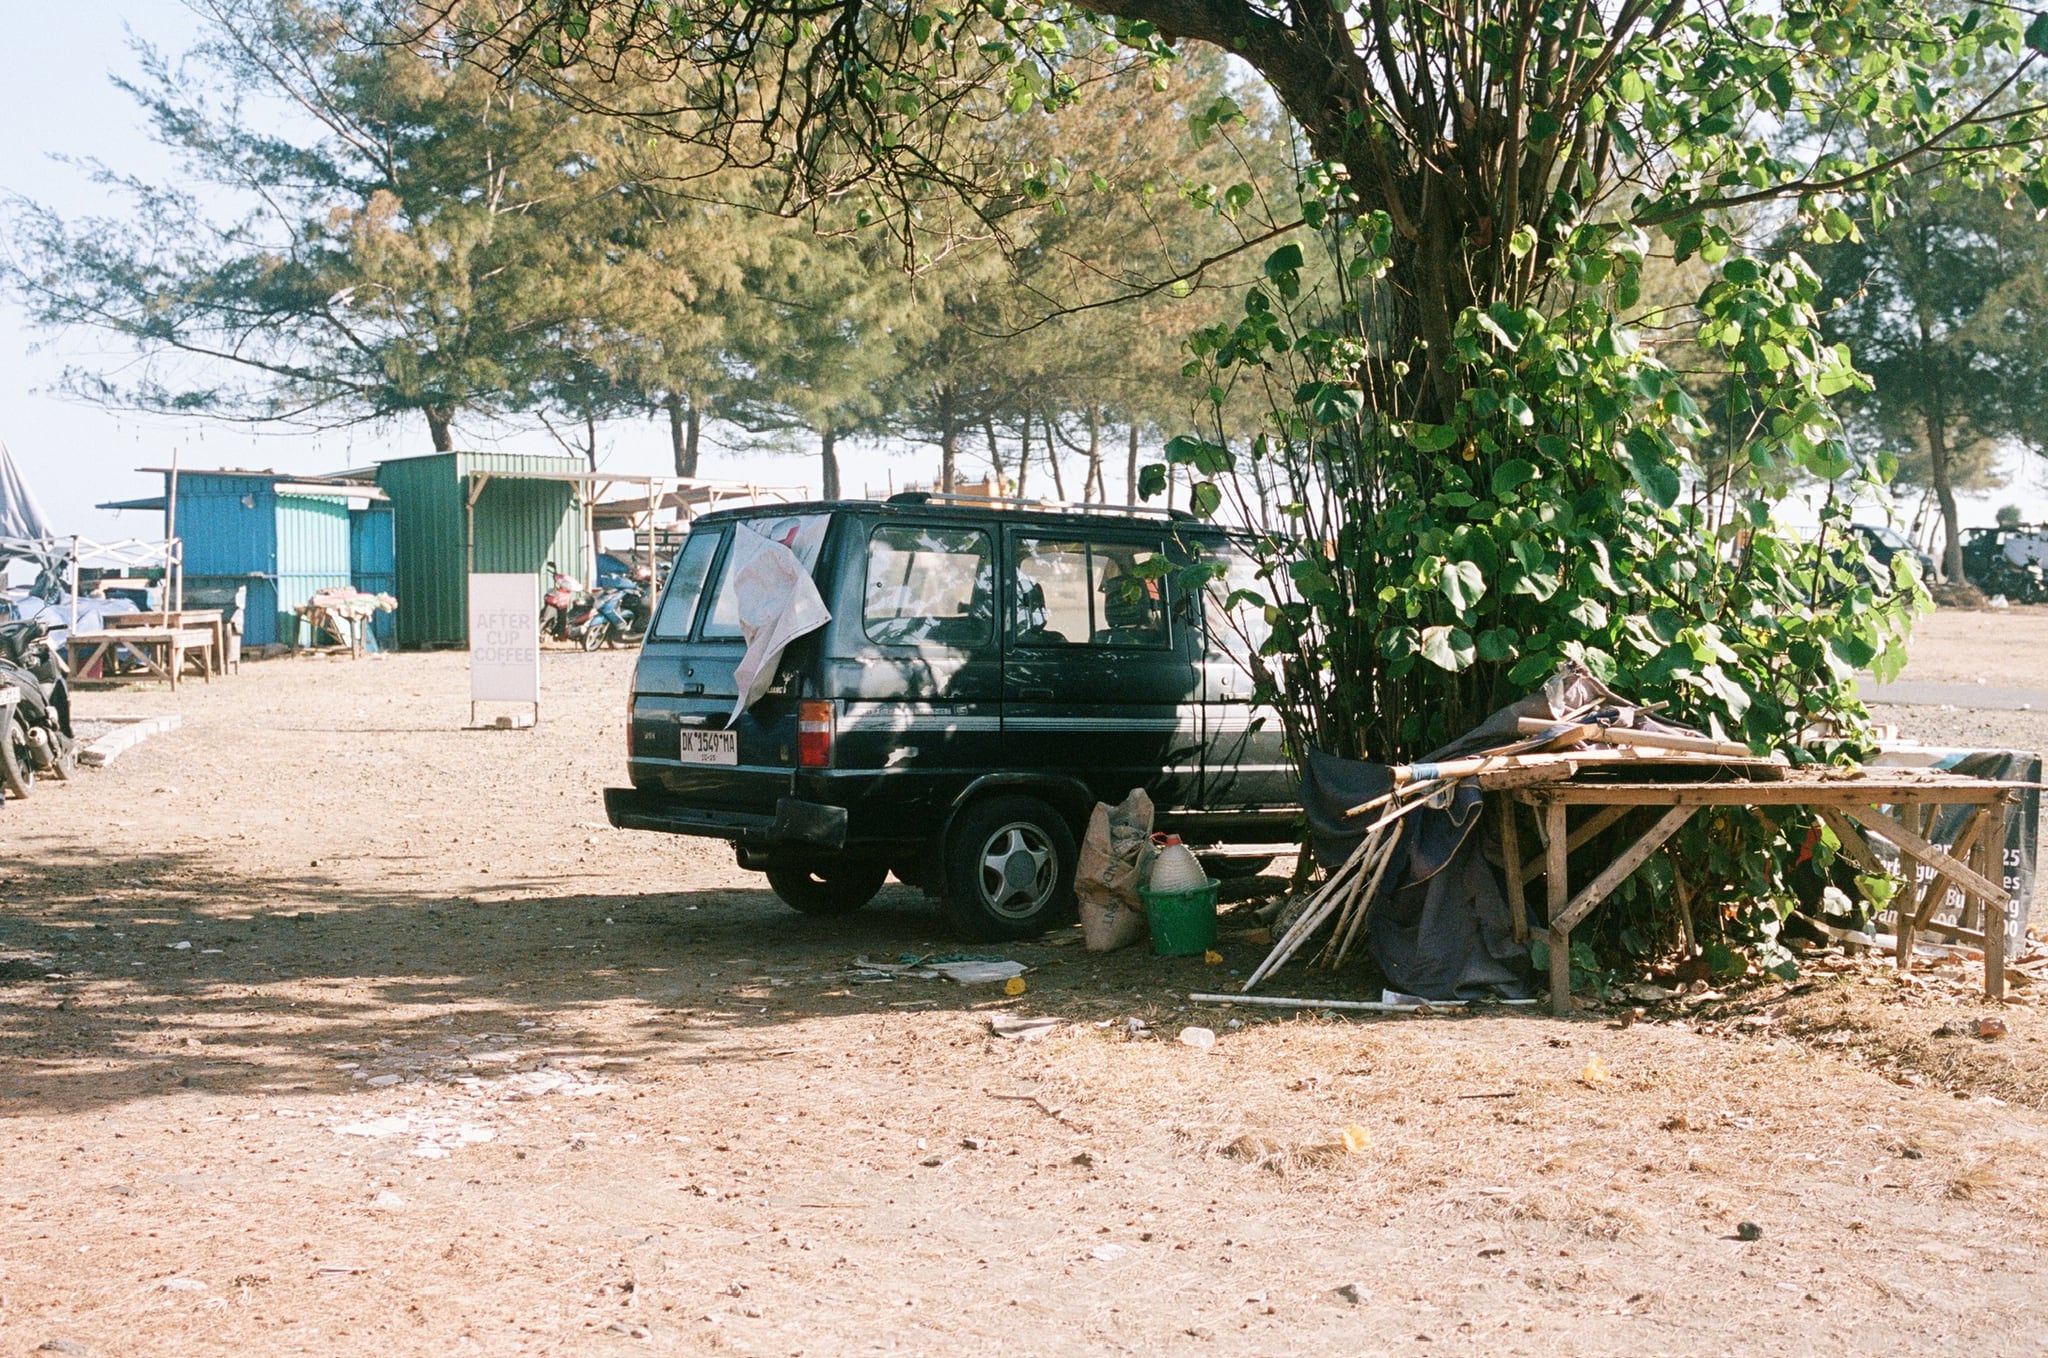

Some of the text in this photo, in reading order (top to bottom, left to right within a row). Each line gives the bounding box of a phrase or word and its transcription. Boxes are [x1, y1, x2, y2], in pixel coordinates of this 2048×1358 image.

[476, 613, 530, 629] AFTER
[487, 630, 520, 645] CUP
[474, 647, 534, 662] COFFEE
[682, 732, 693, 752] DK
[697, 732, 719, 753] 1549
